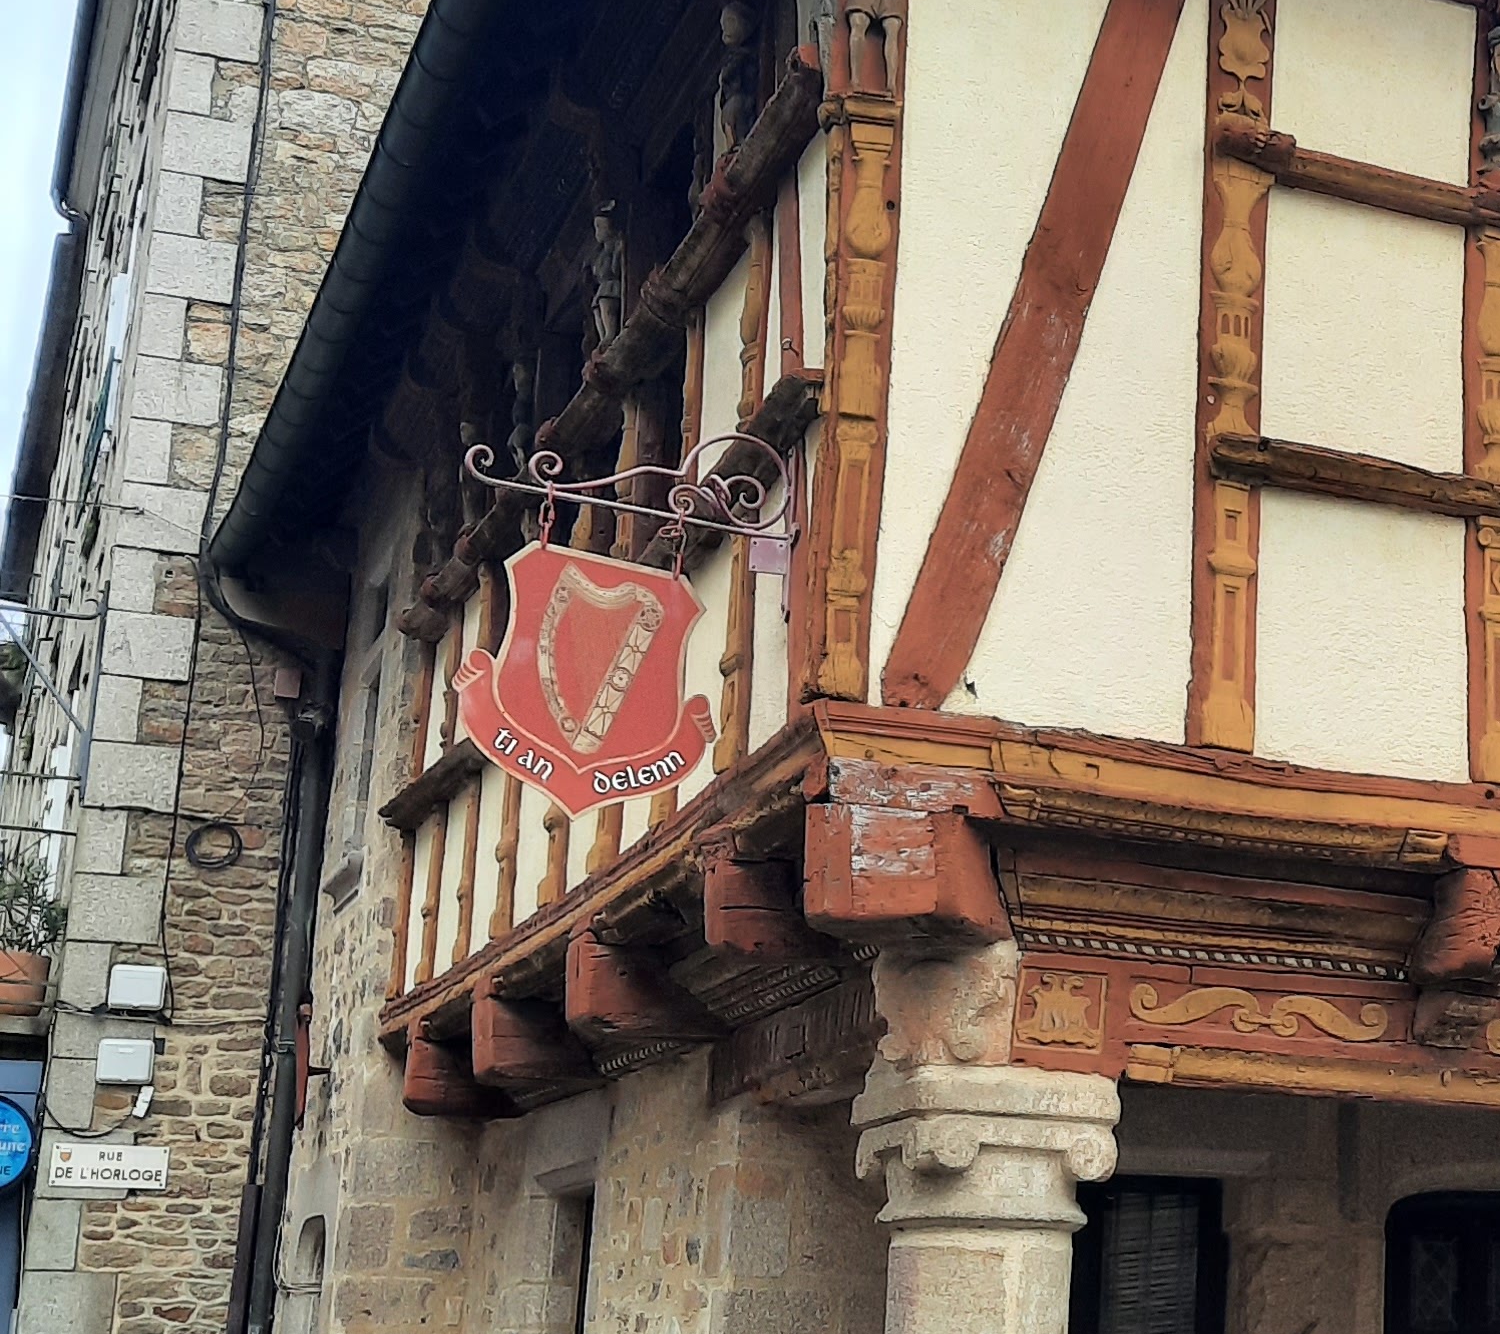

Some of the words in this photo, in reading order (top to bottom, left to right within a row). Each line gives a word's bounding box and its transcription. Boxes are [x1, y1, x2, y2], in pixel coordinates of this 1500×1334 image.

[517, 749, 554, 780] an
[98, 1151, 123, 1162] RUE
[54, 1166, 74, 1179] DE
[79, 1167, 163, 1182] L'HORLOGE
